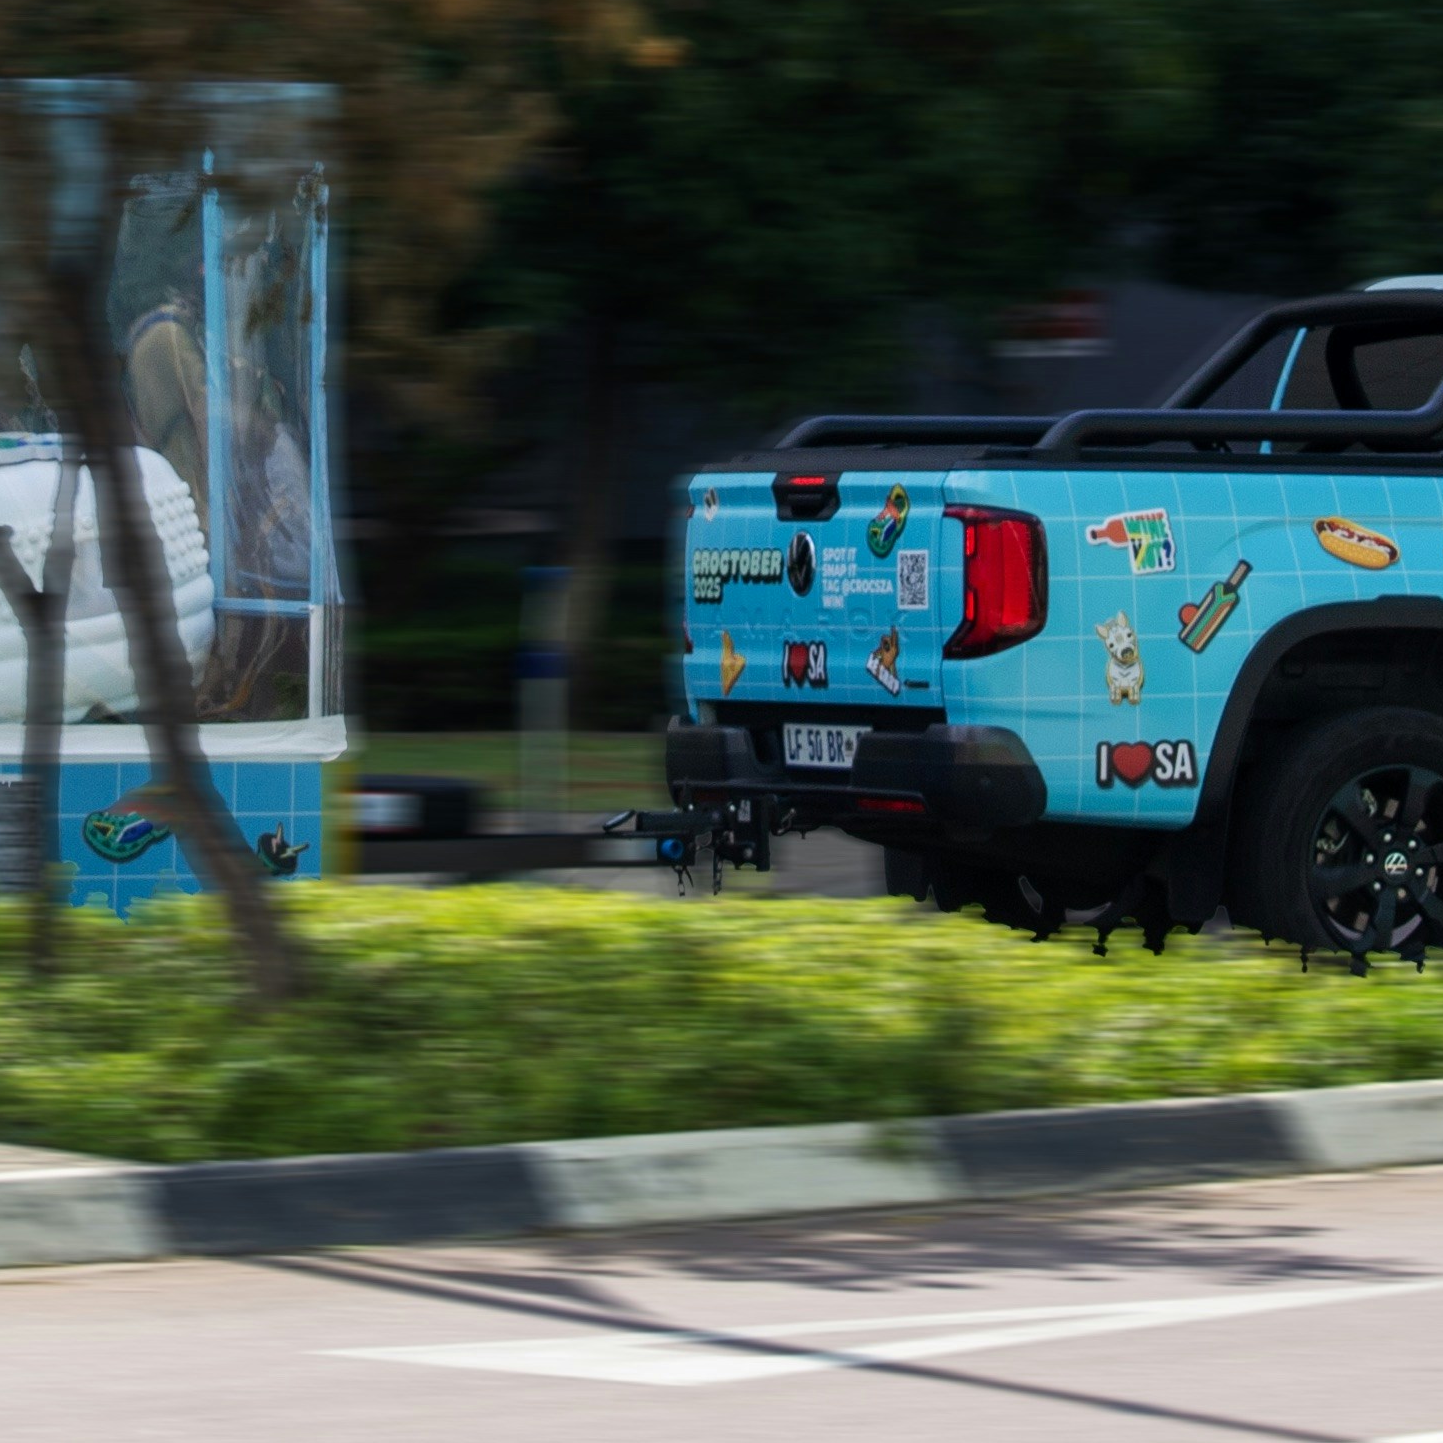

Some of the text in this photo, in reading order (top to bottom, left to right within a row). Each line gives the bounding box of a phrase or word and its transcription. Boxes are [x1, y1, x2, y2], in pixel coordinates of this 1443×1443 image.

[692, 548, 783, 577] CROCTOBER
[693, 577, 722, 599] 2025
[808, 643, 826, 680] SA
[1155, 744, 1193, 781] SA
